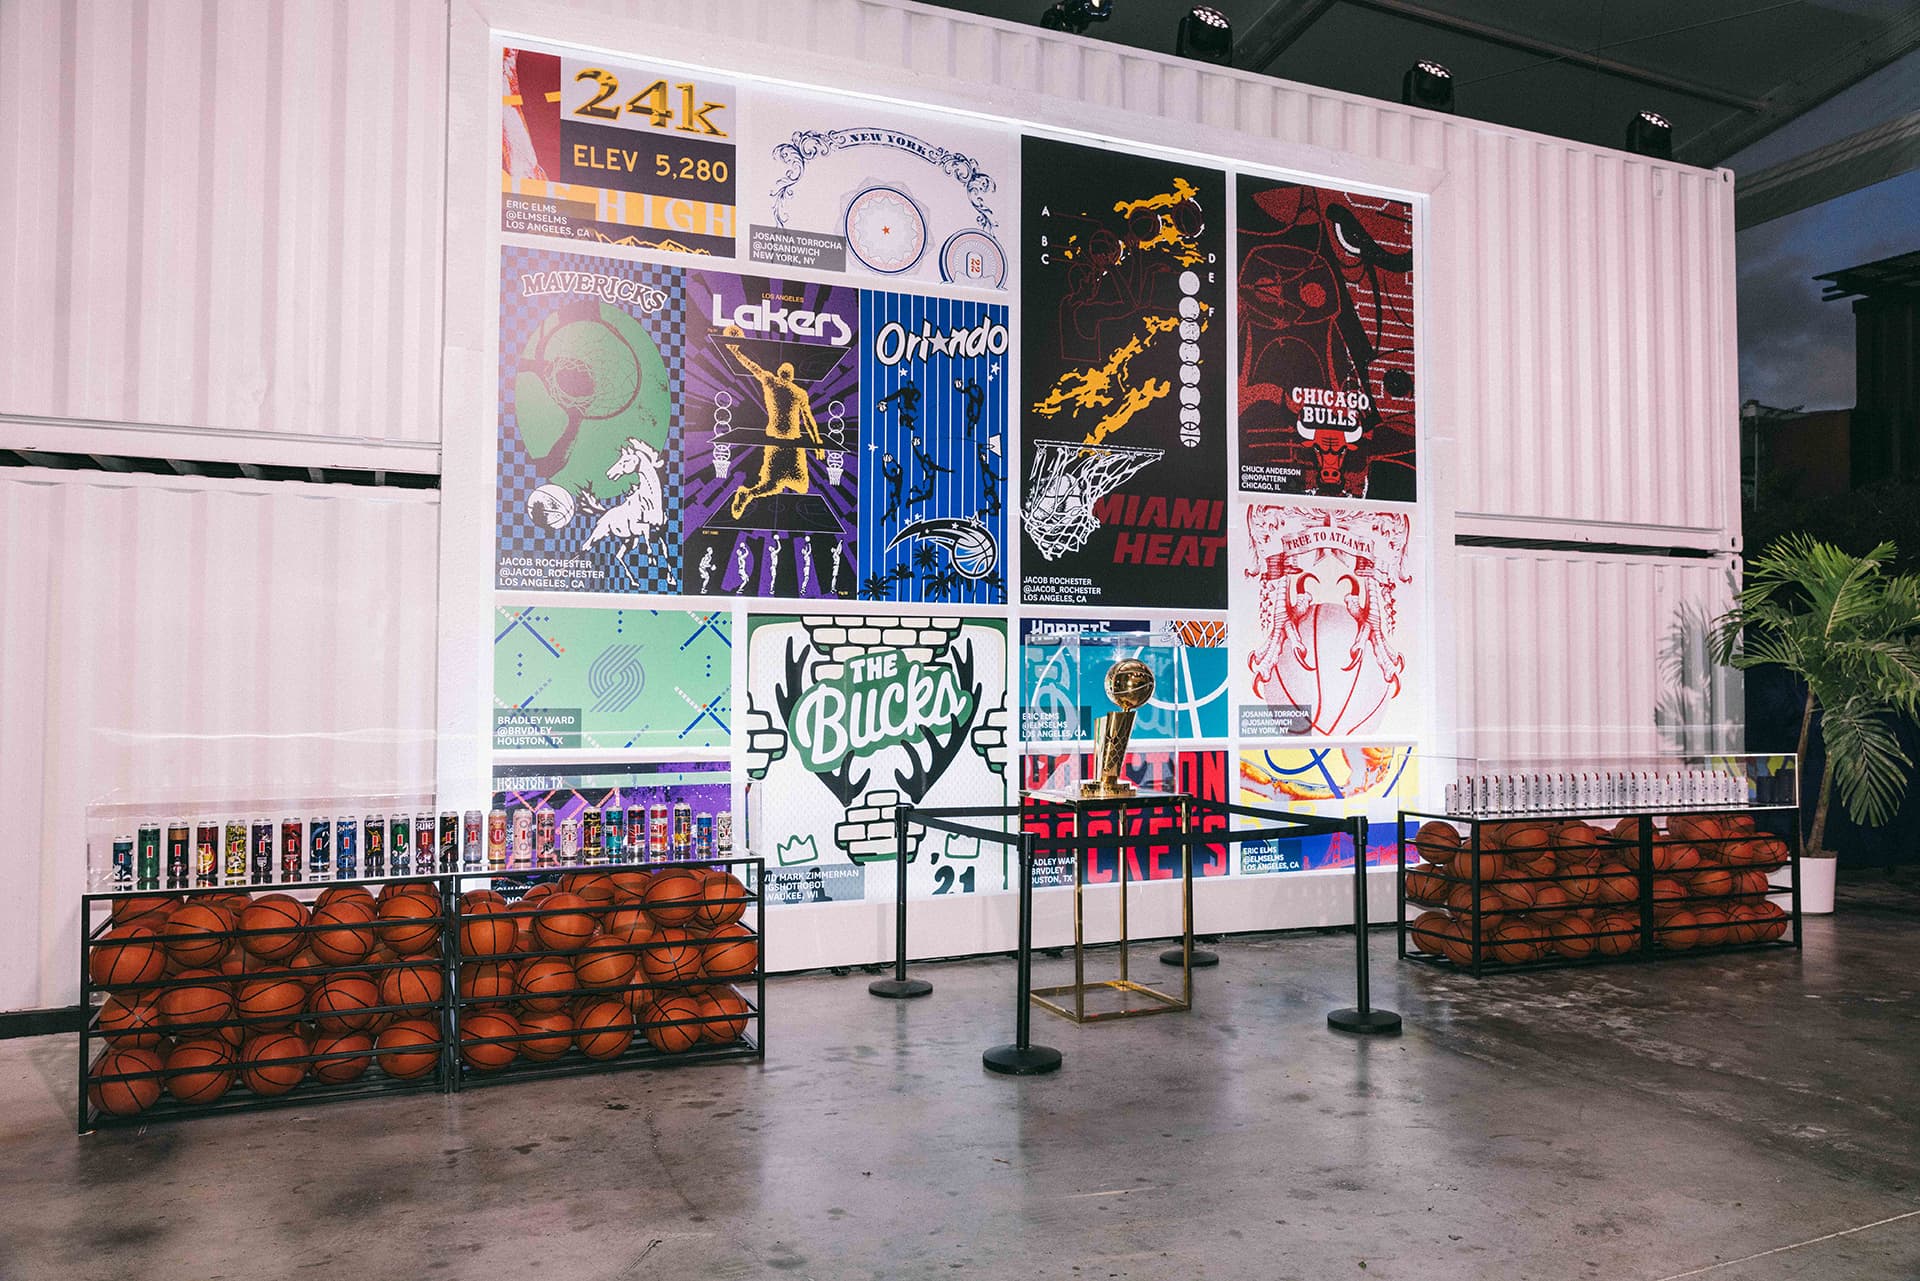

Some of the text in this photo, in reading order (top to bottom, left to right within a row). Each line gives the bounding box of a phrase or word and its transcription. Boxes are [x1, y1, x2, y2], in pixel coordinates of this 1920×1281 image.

[850, 133, 927, 155] NEW YORK
[573, 144, 728, 183] ELEV 5,280
[506, 199, 557, 214] ERIC ELMS
[1041, 206, 1050, 217] A
[506, 210, 568, 225] @ELMSELMS
[506, 220, 591, 238] LOS ANGELES, CA
[753, 232, 843, 250] JOSANNA TORROCHA
[1041, 236, 1048, 246] B
[753, 241, 820, 257] @JOSANDWICH
[753, 251, 816, 265] NEW YORK, NY
[1041, 254, 1050, 265] C
[1208, 253, 1216, 264] D
[1208, 273, 1215, 283] E
[521, 271, 668, 313] MAVERICKS
[762, 292, 804, 303] LOS ANGELES
[1208, 307, 1215, 317] F
[712, 294, 852, 346] Lakers
[1292, 387, 1369, 410] CHICAGO
[1303, 406, 1357, 427] BULLS
[1241, 465, 1301, 476] CHUCK ANDERSON
[1241, 473, 1287, 482] @NOPATTERN
[1241, 482, 1273, 490] CHICAGO,
[1092, 493, 1224, 530] MIAMI
[1286, 531, 1371, 553] TRUE TO ATLANTA
[1112, 532, 1227, 567] HEAT
[500, 557, 592, 569] JACOB ROCHESTER
[500, 567, 605, 579] @JACOB_ROCHESTER
[500, 578, 585, 588] LOS ANGELES, CA
[1023, 576, 1092, 586] JACOB ROCHESTER
[1023, 585, 1102, 595] @JACOB_ROCHESTER
[1039, 594, 1075, 603] ANGELES,
[1076, 595, 1087, 603] CA
[850, 653, 898, 684] THE
[1022, 712, 1039, 720] ERIC
[1241, 710, 1309, 718] JOSANNA TORROCHA
[497, 716, 575, 724] BRADLEY WARD
[497, 726, 552, 737] @BRVDLEY
[1022, 730, 1036, 738] LOS
[1241, 727, 1257, 735] NEW
[1259, 727, 1278, 735] YORK,
[497, 737, 563, 746] HOUSTON, TX
[1243, 846, 1277, 855] ERIC ELMS
[1034, 856, 1076, 867] ADLEY WAR
[1243, 863, 1256, 871] LOS
[1290, 861, 1299, 869] CA
[751, 869, 859, 883] DVID MARK ZIMMERMAN
[1032, 866, 1064, 875] BRVDLEY
[1032, 875, 1062, 884] USTON,
[766, 890, 819, 901] WAUKEE, WI
